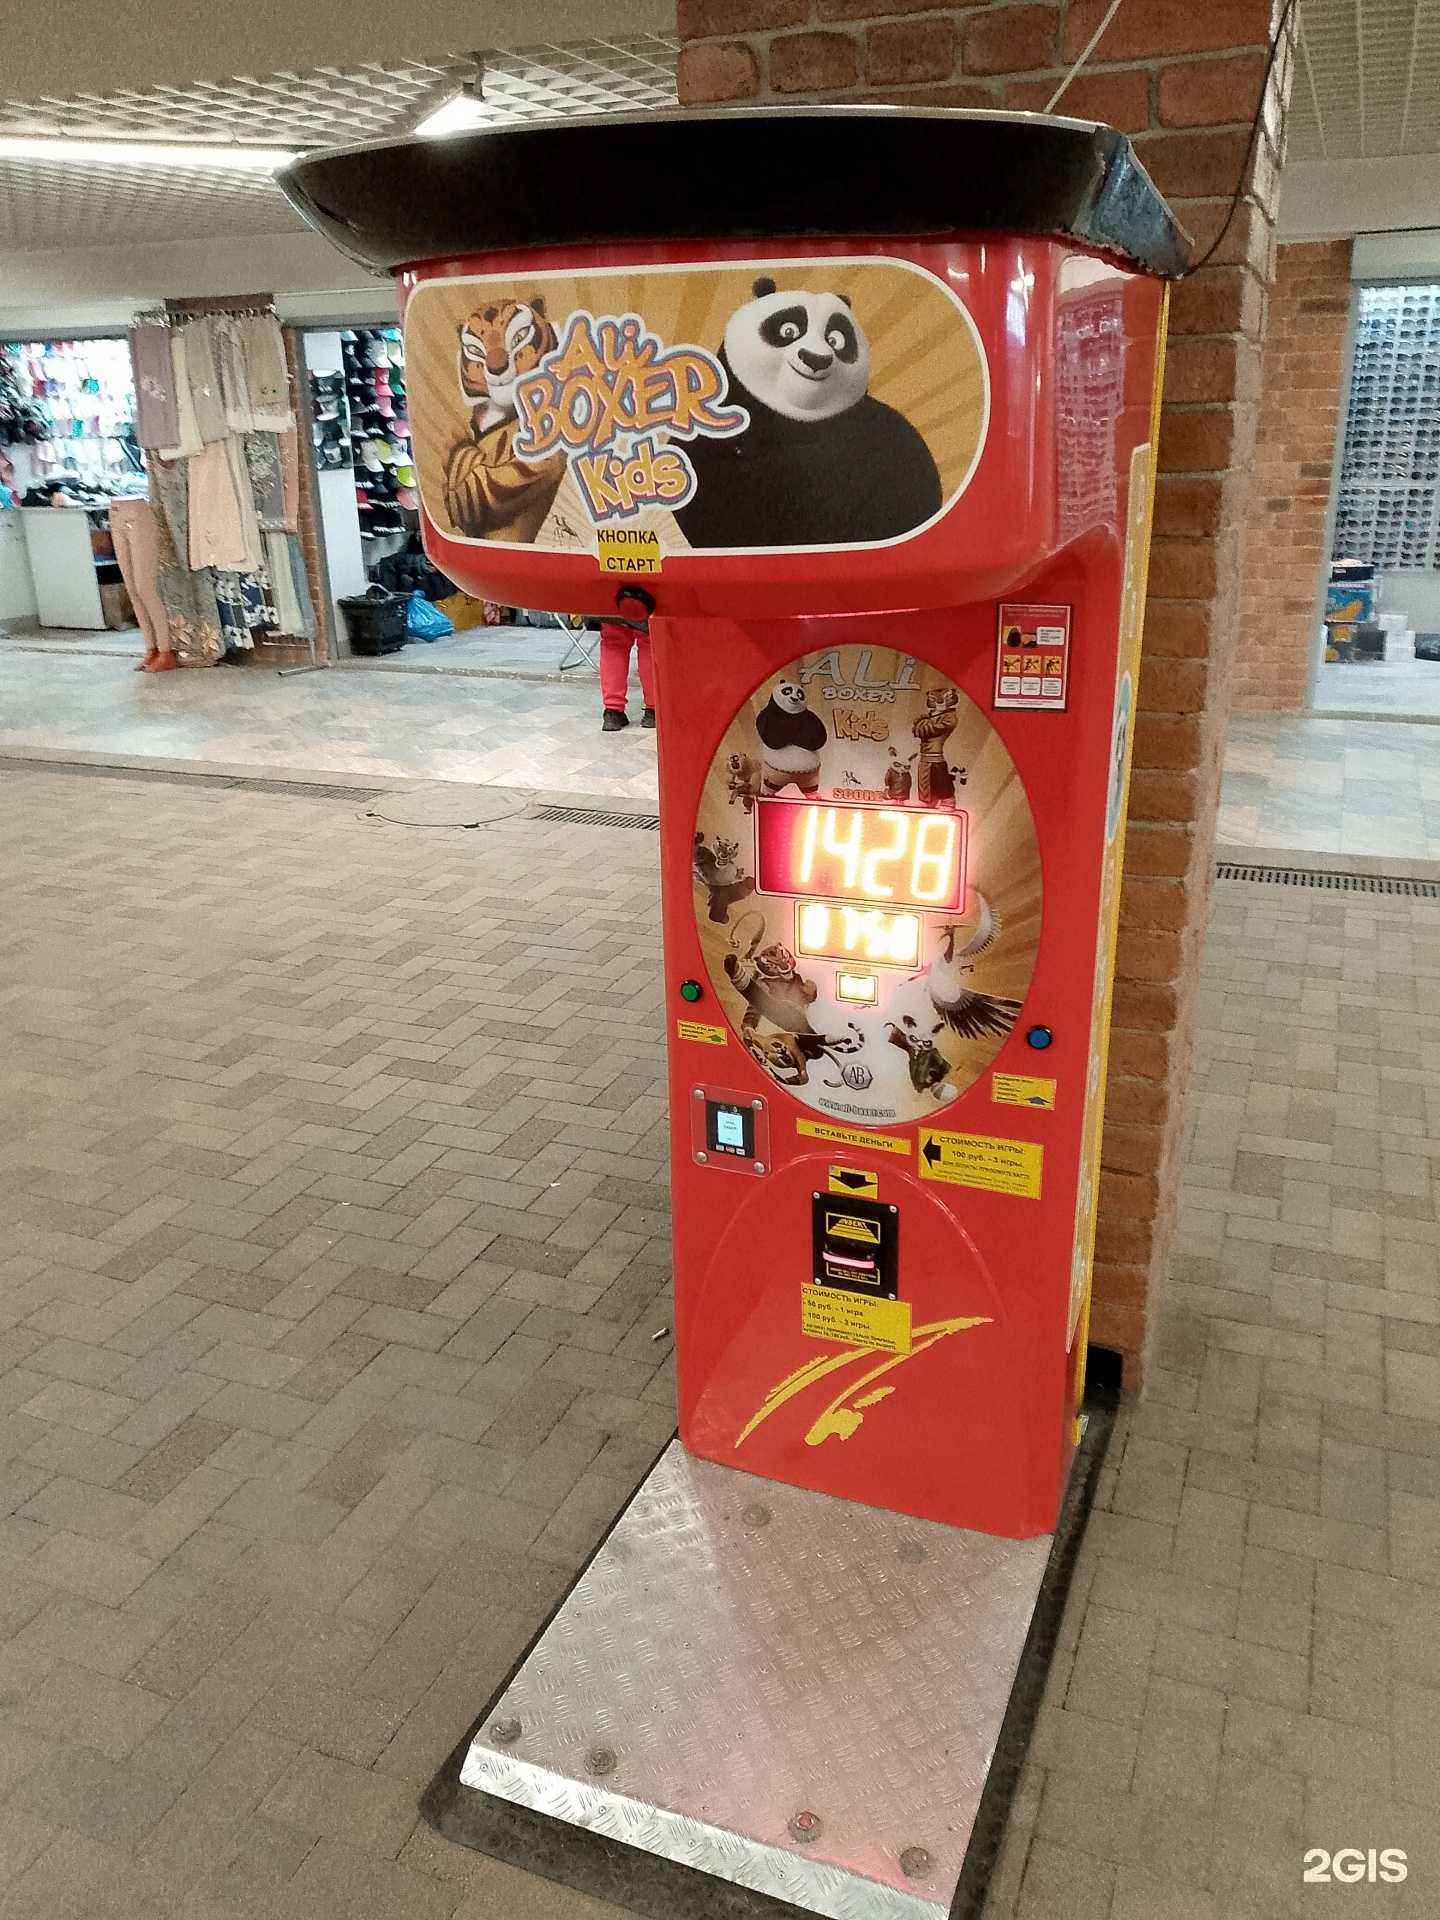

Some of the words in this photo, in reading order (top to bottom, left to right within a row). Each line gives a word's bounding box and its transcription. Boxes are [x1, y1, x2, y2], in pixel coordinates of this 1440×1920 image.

[516, 352, 745, 456] BOXER
[574, 440, 692, 521] Kids
[596, 529, 659, 545] КНОПКА
[606, 557, 656, 572] СТАРТ
[832, 707, 890, 742] Kids
[798, 804, 957, 902] 1428
[814, 1127, 858, 1142] ВСТАВЬТЕ
[859, 1136, 894, 1149] ДЕНЬГИ
[939, 1135, 996, 1150] СТОИМОСТЬ
[952, 1150, 967, 1159] 100
[802, 1287, 852, 1303] СТОИМОСТЬ
[807, 1312, 821, 1320] 100
